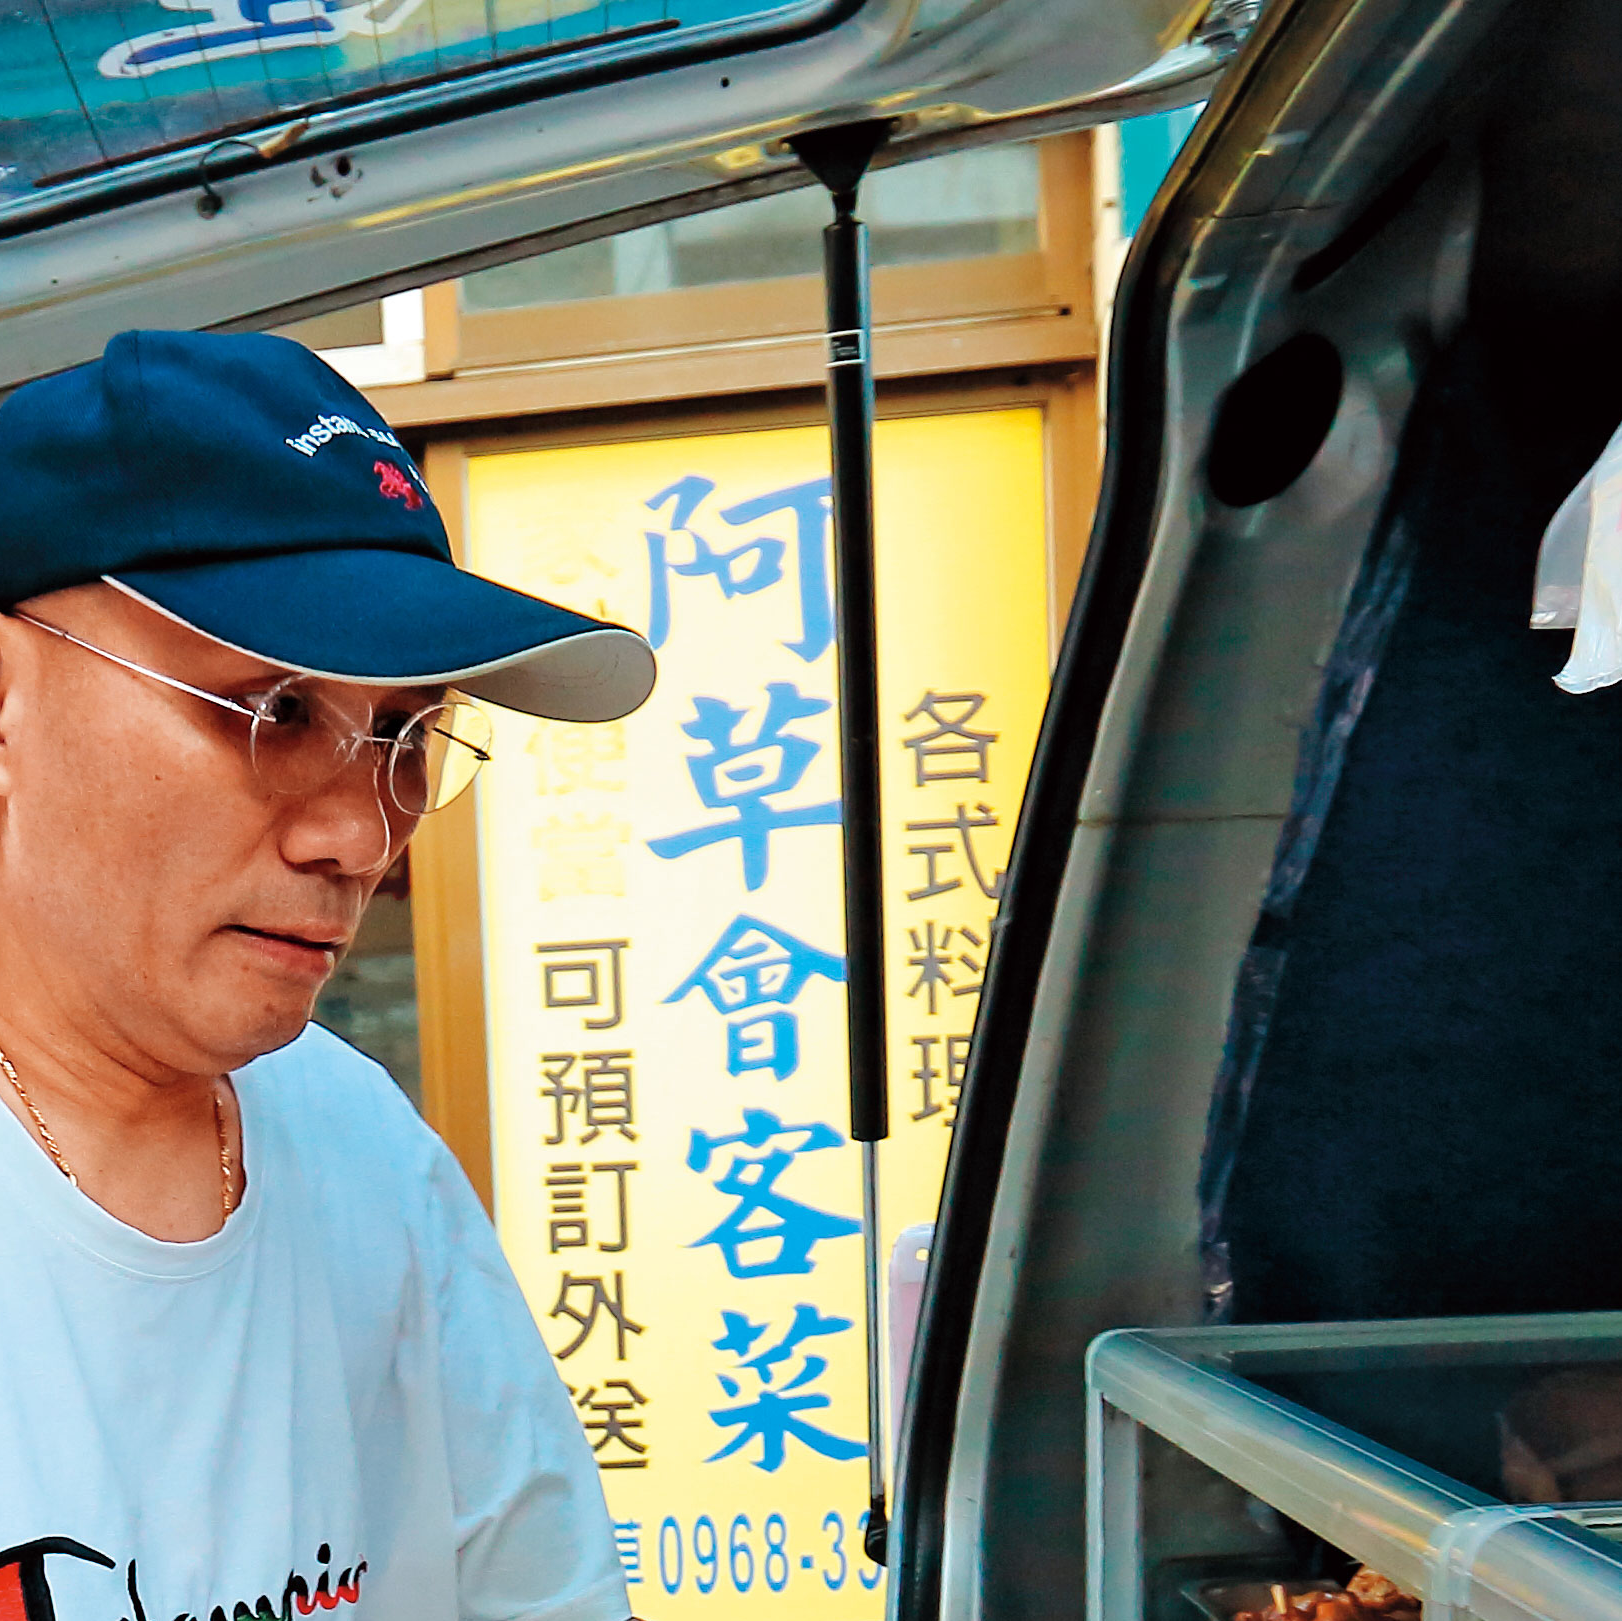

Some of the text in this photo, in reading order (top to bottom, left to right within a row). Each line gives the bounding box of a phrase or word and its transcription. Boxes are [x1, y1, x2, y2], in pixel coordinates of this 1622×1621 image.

[645, 475, 869, 1473] 阿草會客菜
